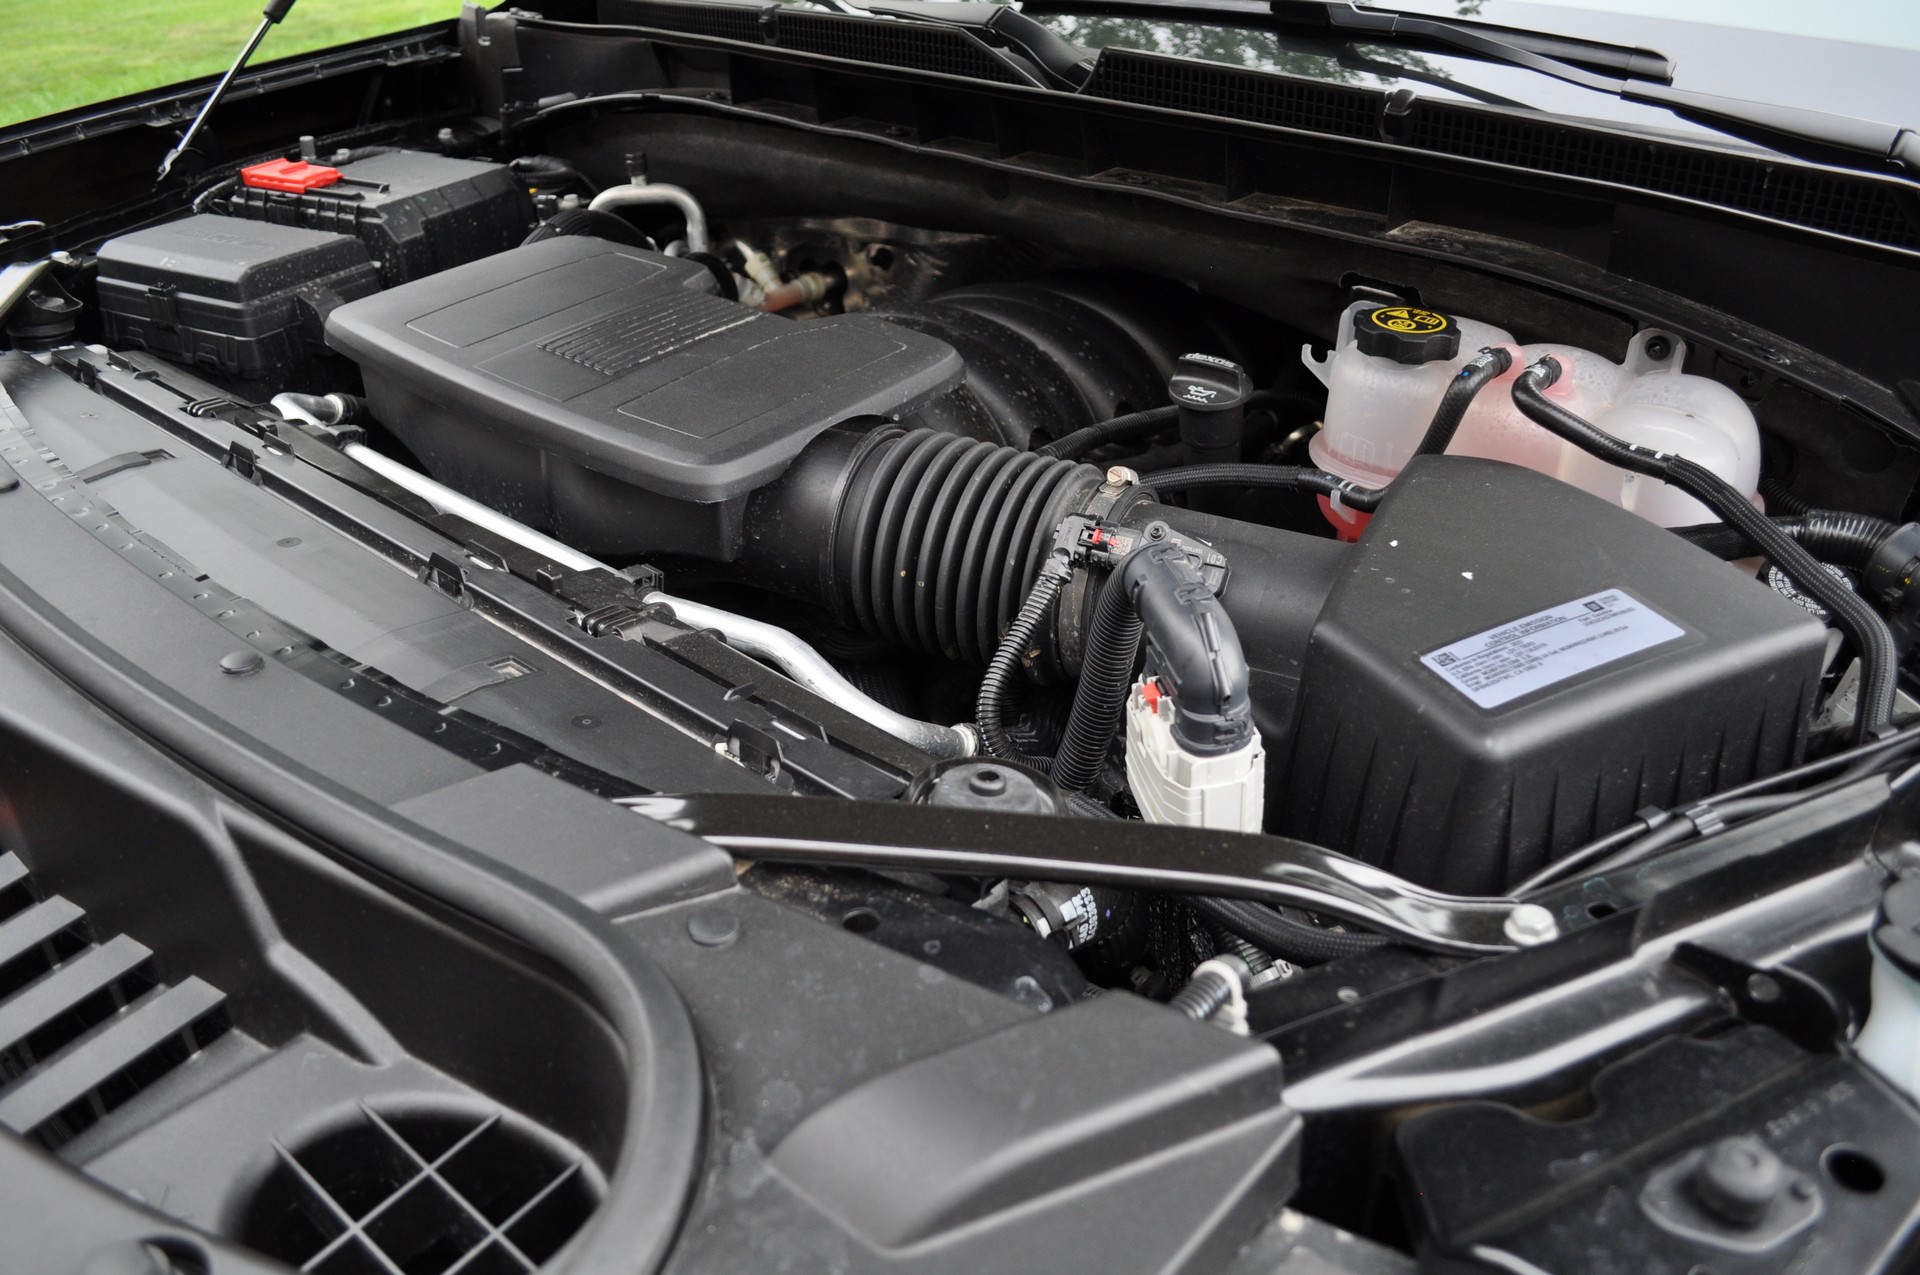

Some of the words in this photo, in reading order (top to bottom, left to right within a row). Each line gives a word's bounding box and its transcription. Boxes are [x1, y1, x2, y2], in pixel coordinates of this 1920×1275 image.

[1185, 352, 1236, 368] dexos
[1485, 632, 1521, 647] CONTROL
[1520, 616, 1567, 635] INFORMATION
[1489, 627, 1520, 640] VEHICLE
[1520, 615, 1554, 629] EMISSION
